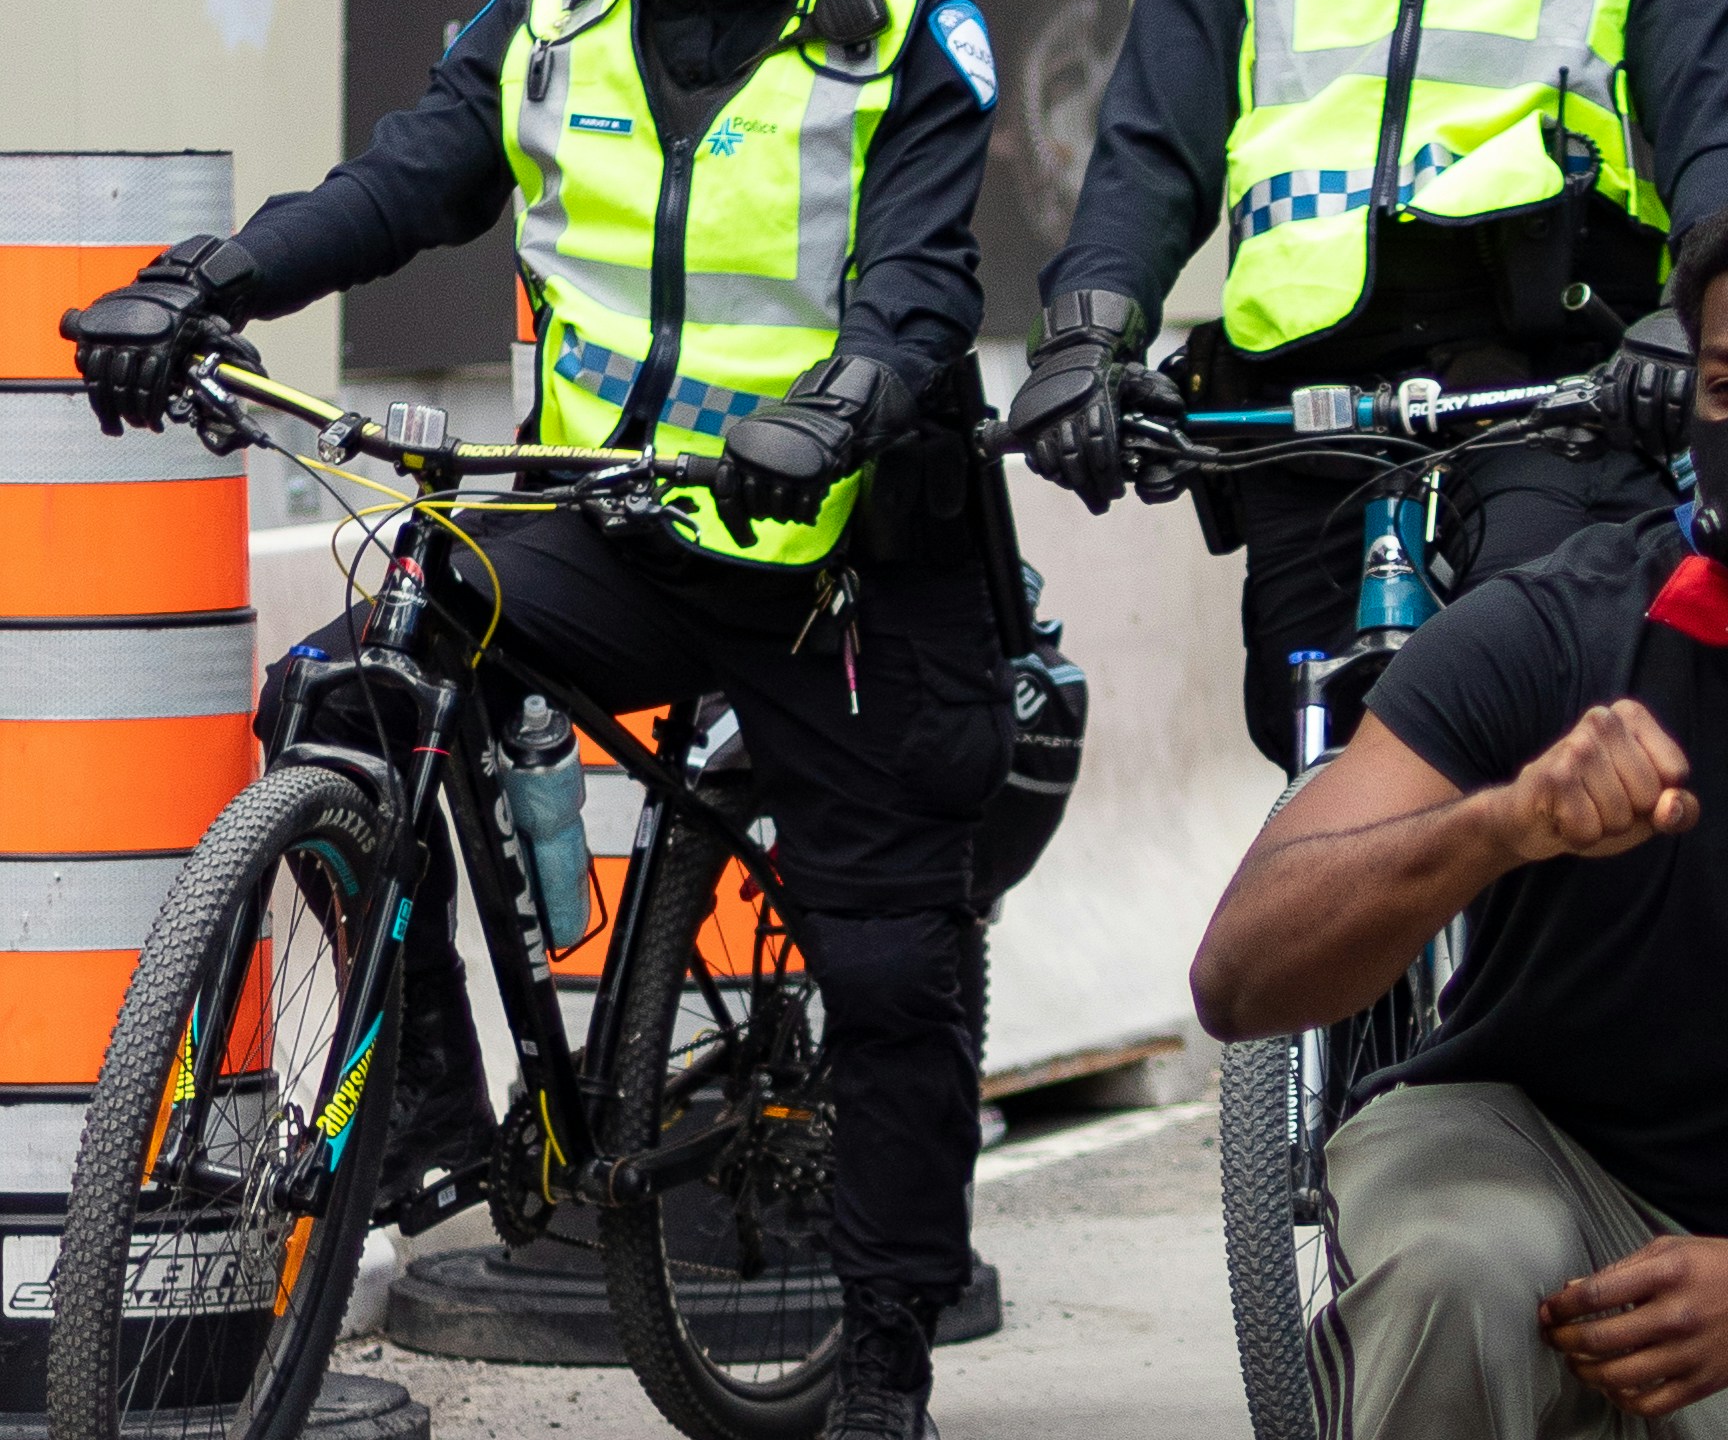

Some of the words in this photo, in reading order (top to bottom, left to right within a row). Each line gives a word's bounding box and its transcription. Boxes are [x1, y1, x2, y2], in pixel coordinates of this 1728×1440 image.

[733, 116, 779, 134] Police
[457, 444, 518, 457] ROCKY
[518, 444, 613, 459] MOUNTAIN
[314, 808, 376, 854] MAXXIS
